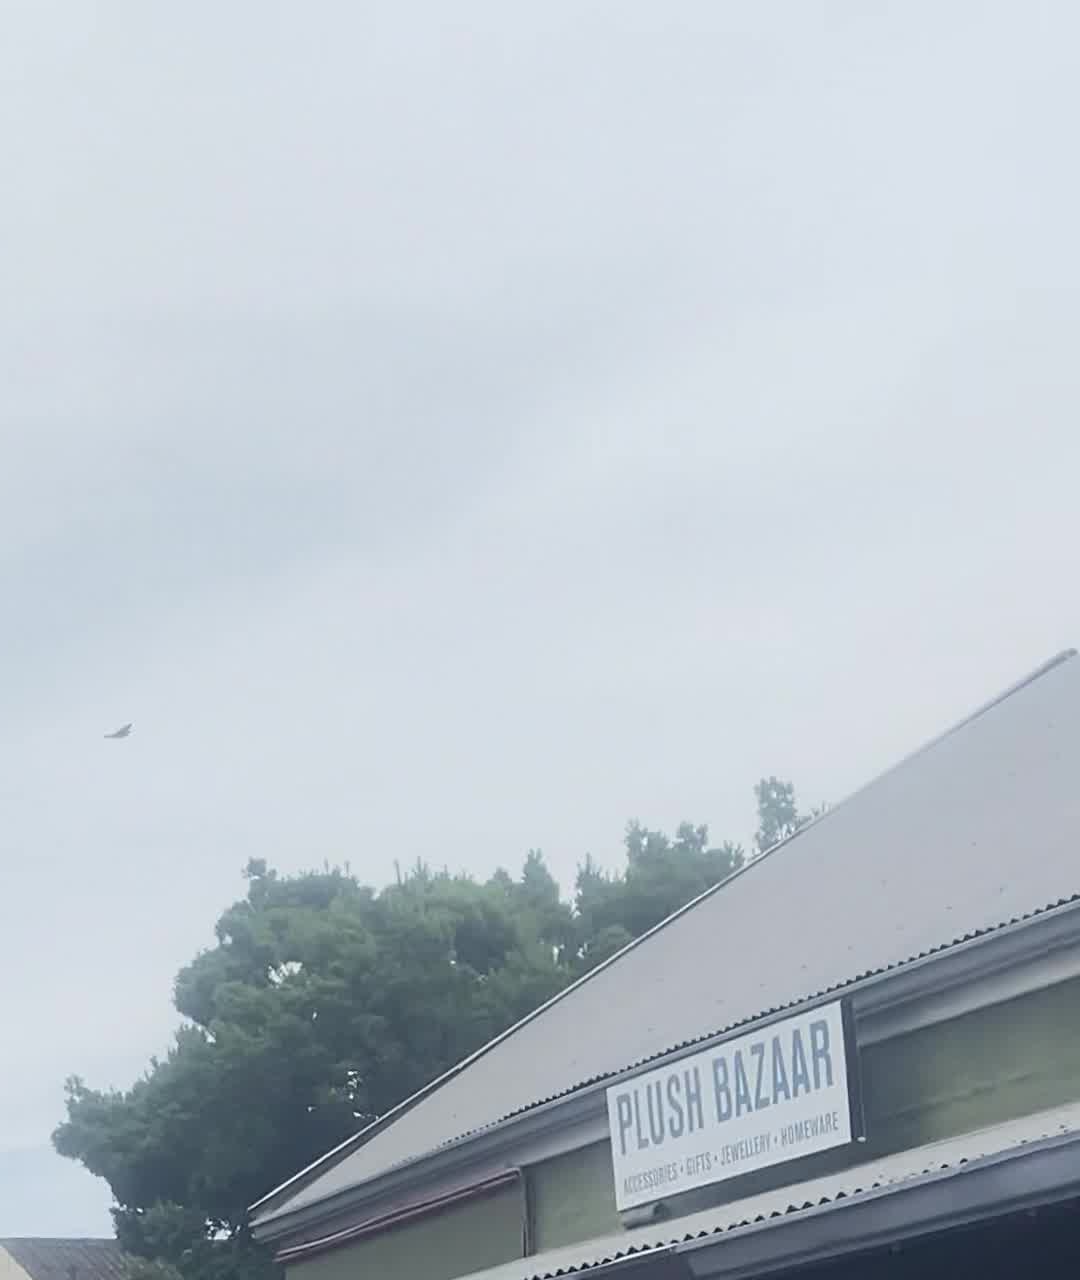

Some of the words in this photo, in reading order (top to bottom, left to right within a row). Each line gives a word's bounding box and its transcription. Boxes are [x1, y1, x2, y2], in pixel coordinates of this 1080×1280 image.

[616, 1067, 704, 1156] PLUSH
[711, 1019, 834, 1123] BAZAAR
[623, 1162, 678, 1194] ACCESSORIES
[686, 1151, 712, 1176] GIFTS
[720, 1132, 770, 1167] JEWELLERY
[781, 1111, 839, 1148] HOMEWARE
